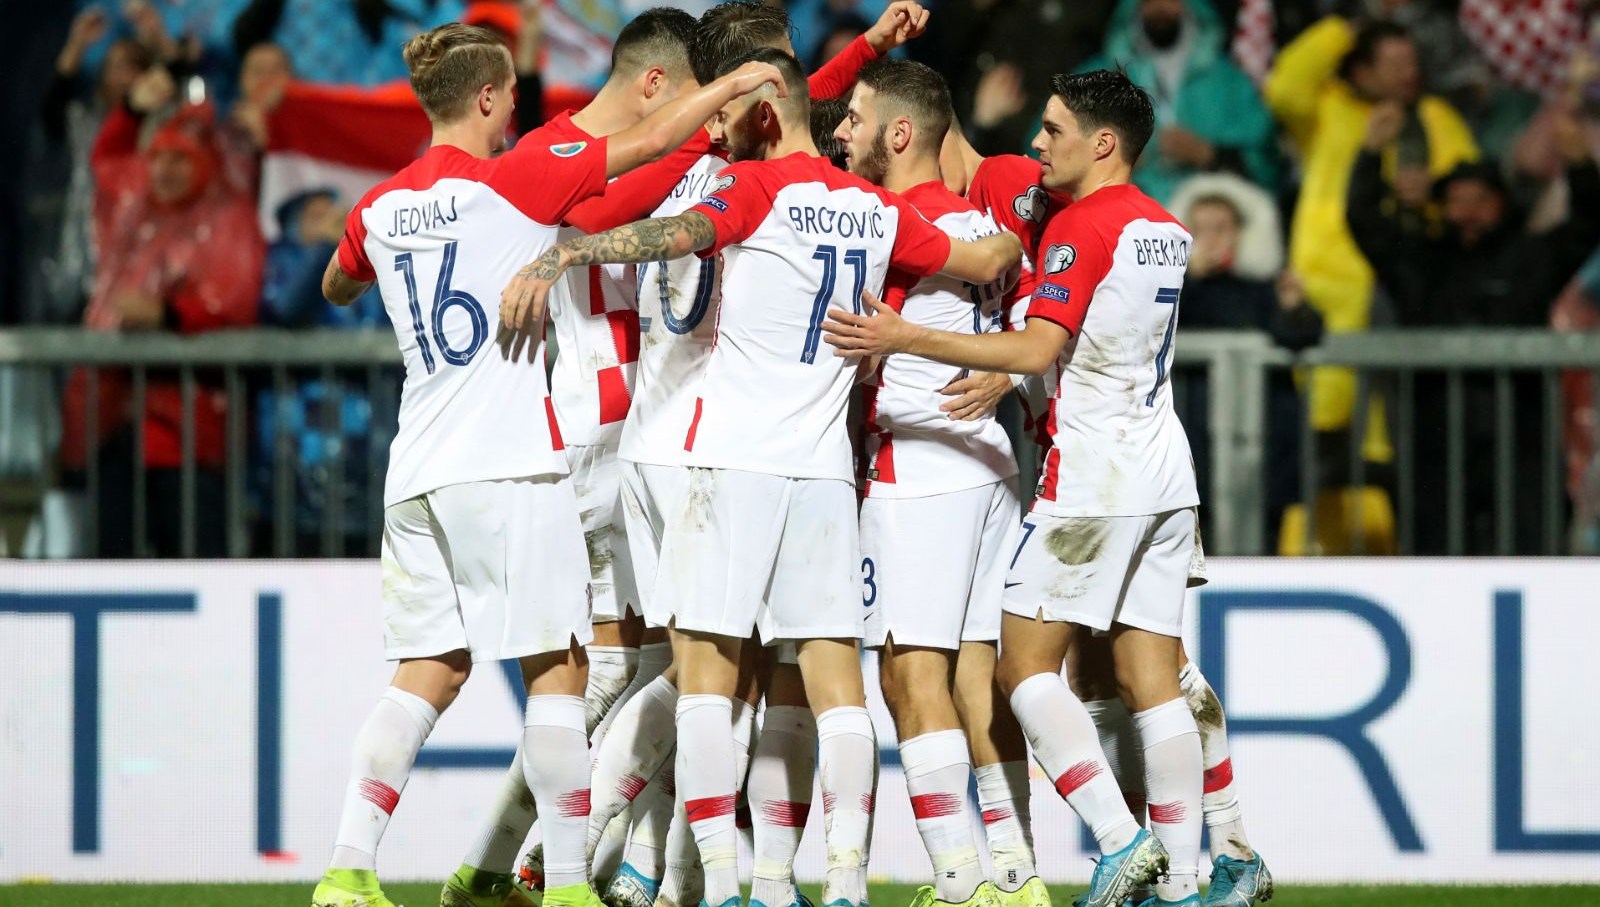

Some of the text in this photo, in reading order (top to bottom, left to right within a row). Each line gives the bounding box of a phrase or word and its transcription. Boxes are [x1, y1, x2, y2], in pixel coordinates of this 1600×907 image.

[388, 196, 457, 238] JEDVAJ
[1134, 239, 1187, 267] BREKALO
[394, 242, 488, 375] 16
[800, 245, 866, 364] 11
[1146, 288, 1180, 407] 7
[1010, 522, 1036, 570] 7
[861, 557, 876, 607] 3
